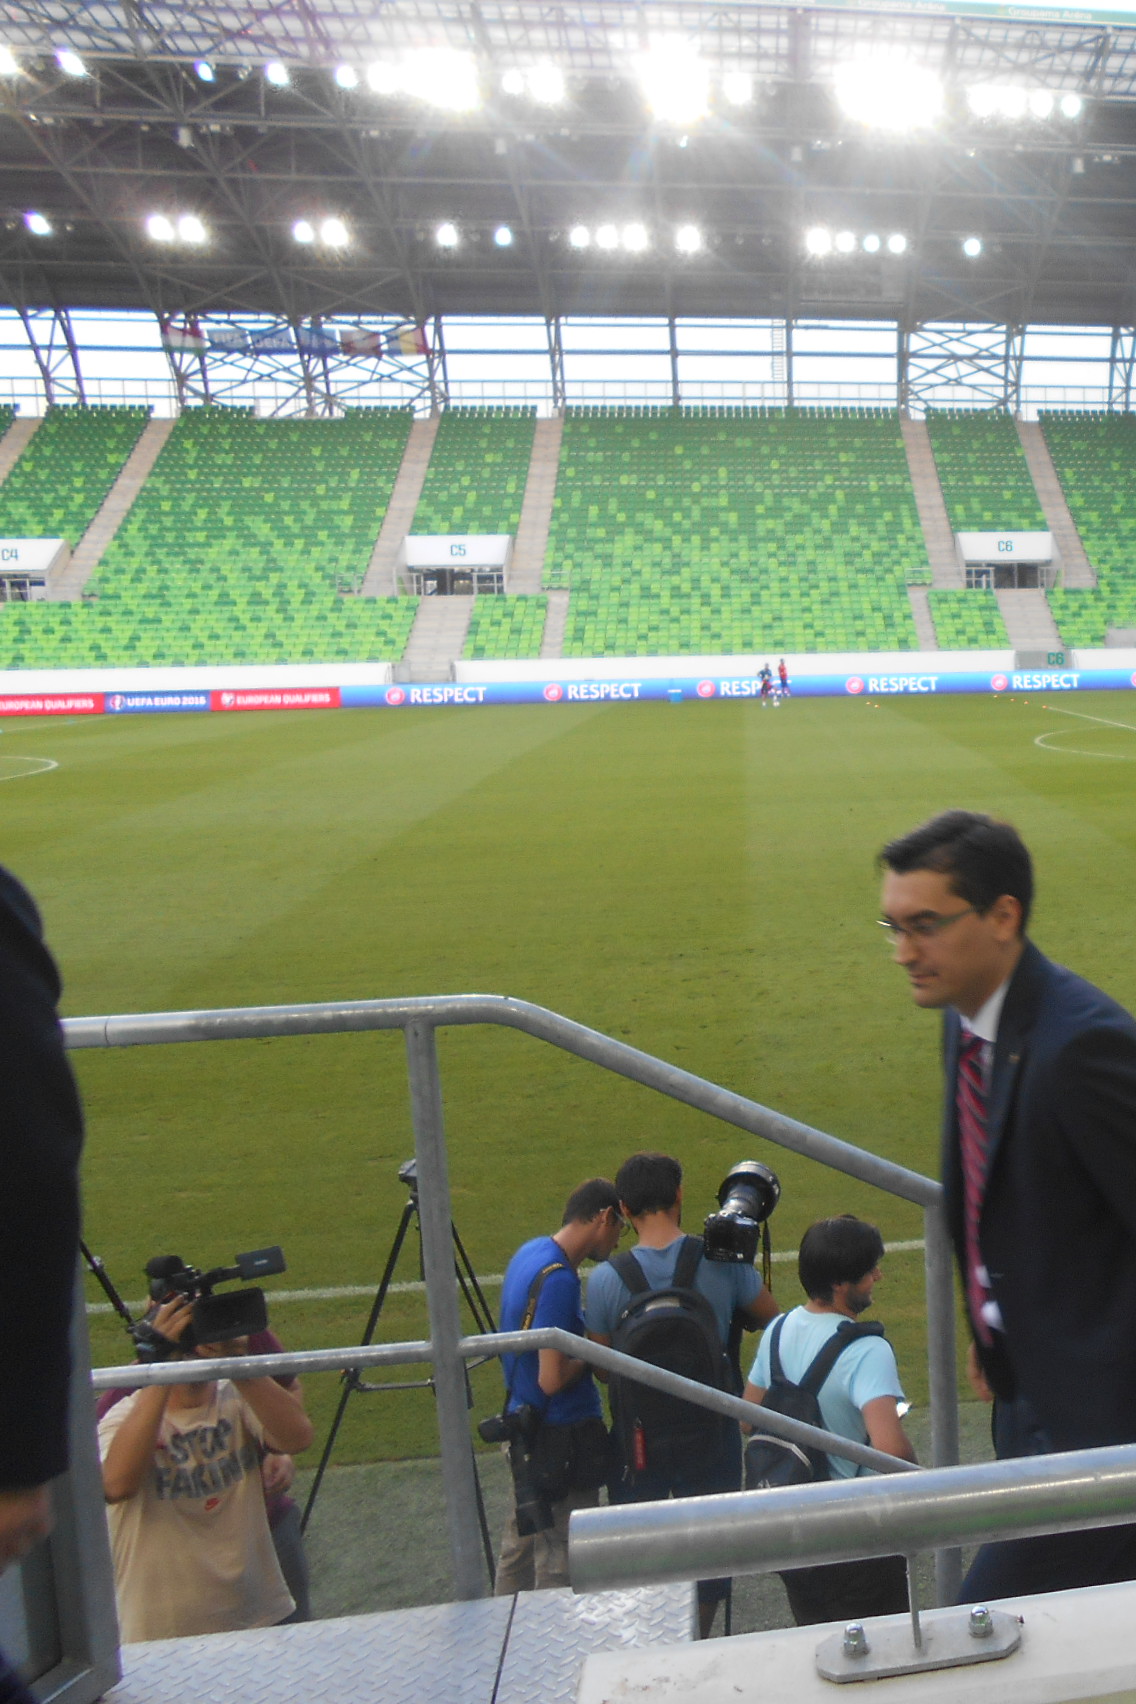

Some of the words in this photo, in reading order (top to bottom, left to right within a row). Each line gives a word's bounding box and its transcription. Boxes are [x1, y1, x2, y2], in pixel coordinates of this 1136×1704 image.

[1008, 7, 1060, 19] Groupama
[450, 544, 466, 556] C5
[998, 540, 1013, 552] C6
[2, 548, 19, 561] C4
[1047, 652, 1065, 665] C6
[868, 676, 938, 692] RESPECT
[1012, 674, 1080, 689] RESPECT
[410, 687, 487, 703] RESPECT
[567, 683, 642, 699] RESPECT
[0, 700, 43, 711] UROPEAN
[44, 698, 95, 710] QUALIFIERS
[127, 697, 153, 707] UEFA
[154, 696, 181, 706] EURO
[182, 695, 206, 706] 2016
[236, 694, 282, 705] EUROPEAN
[282, 692, 331, 705] QUALIFIERS
